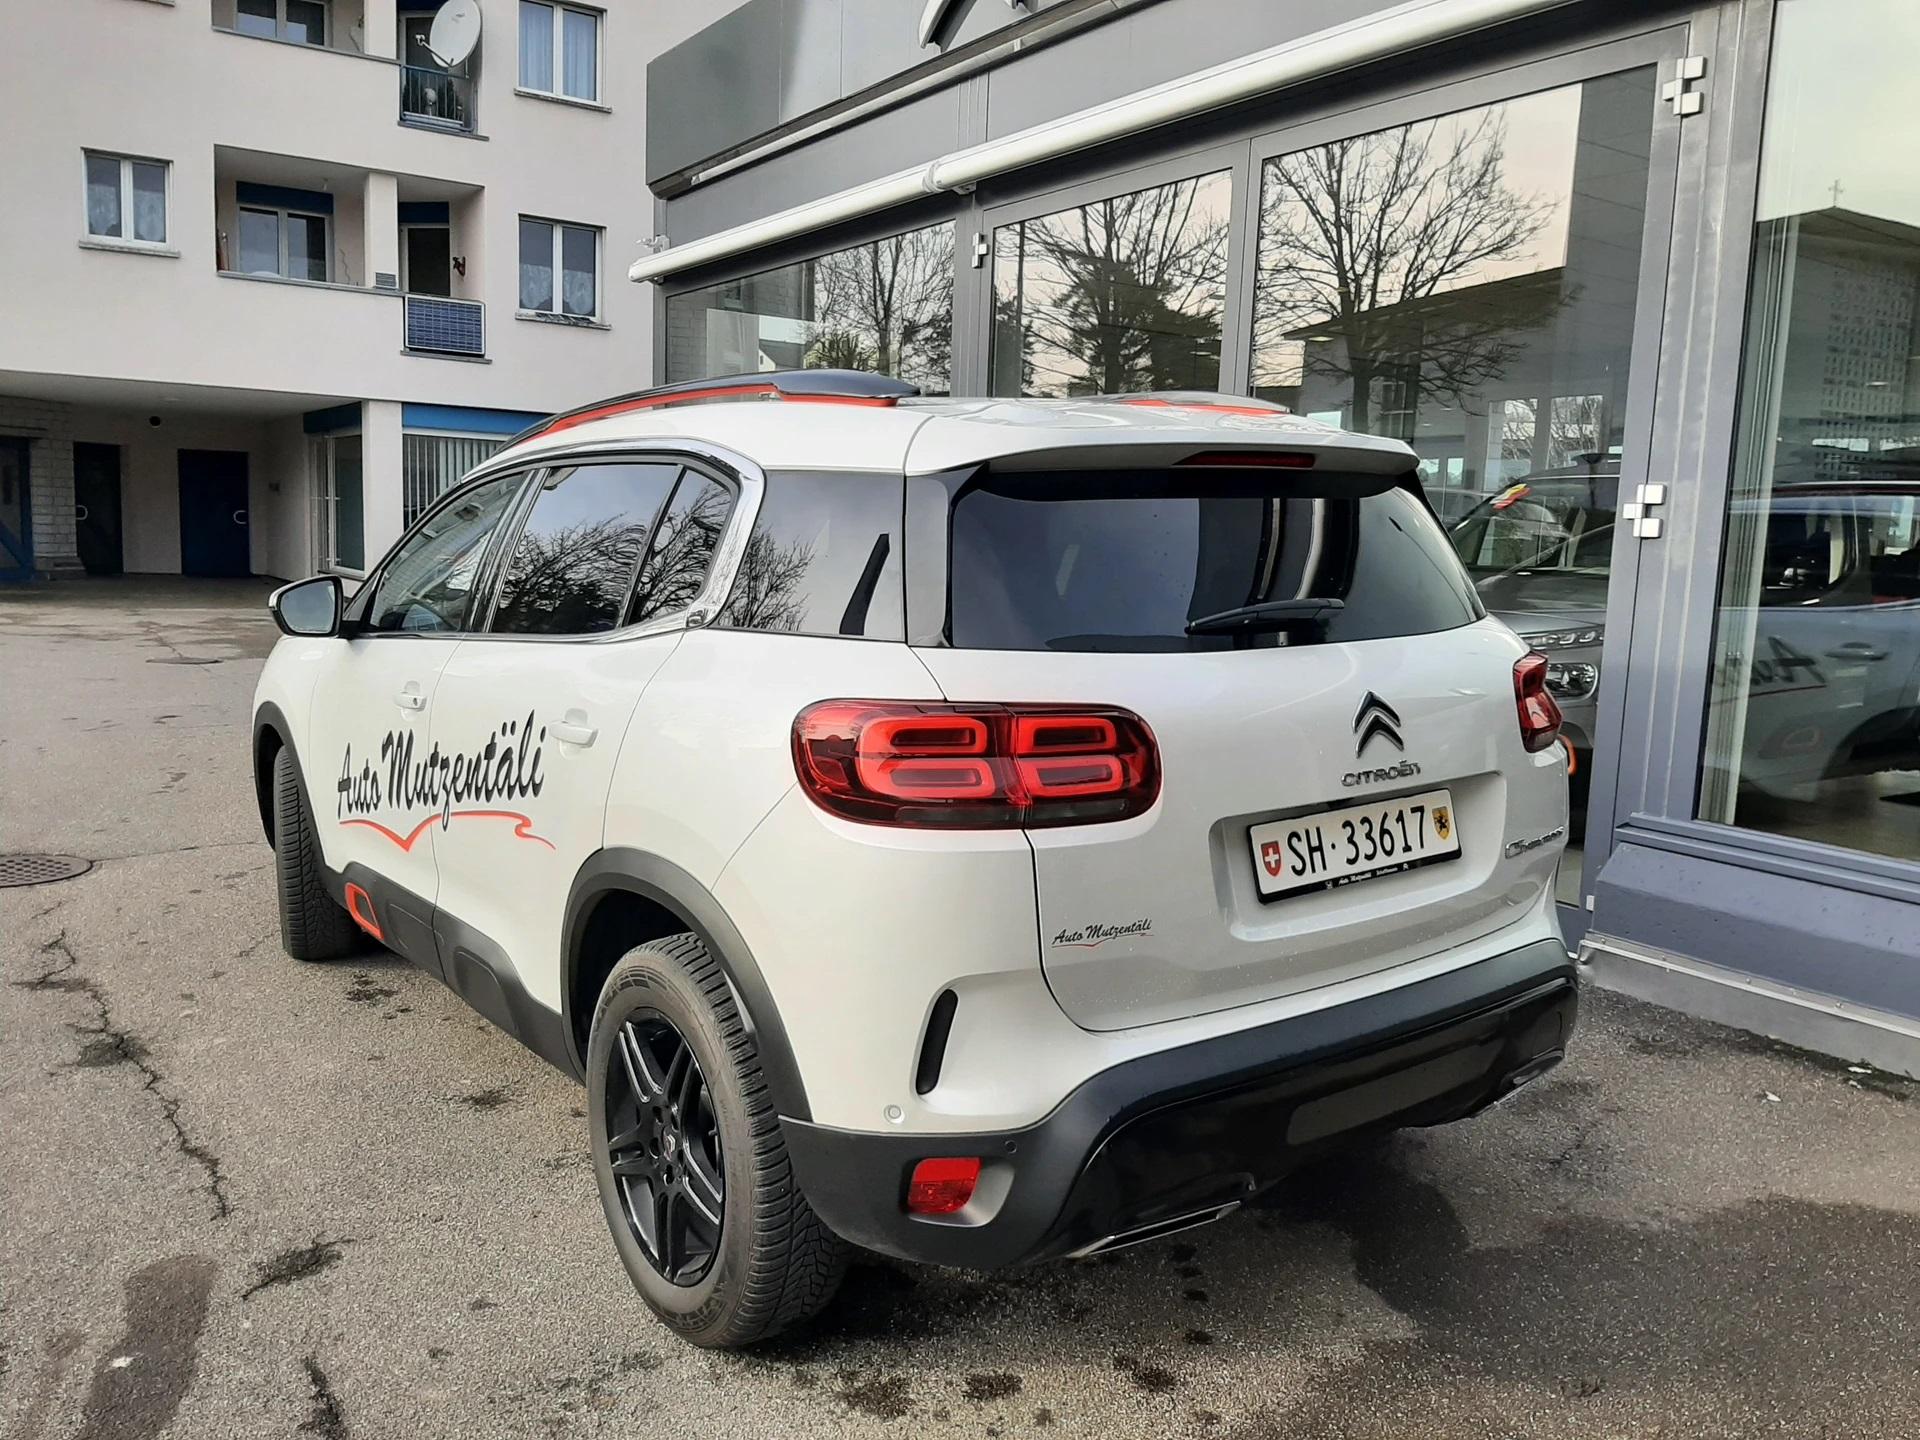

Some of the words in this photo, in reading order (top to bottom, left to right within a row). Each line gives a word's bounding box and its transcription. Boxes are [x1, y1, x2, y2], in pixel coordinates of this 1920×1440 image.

[338, 742, 381, 820] Auto
[382, 709, 547, 832] Mutzentäli
[1052, 929, 1083, 945] Auto
[1085, 918, 1152, 940] Mutzentäli
